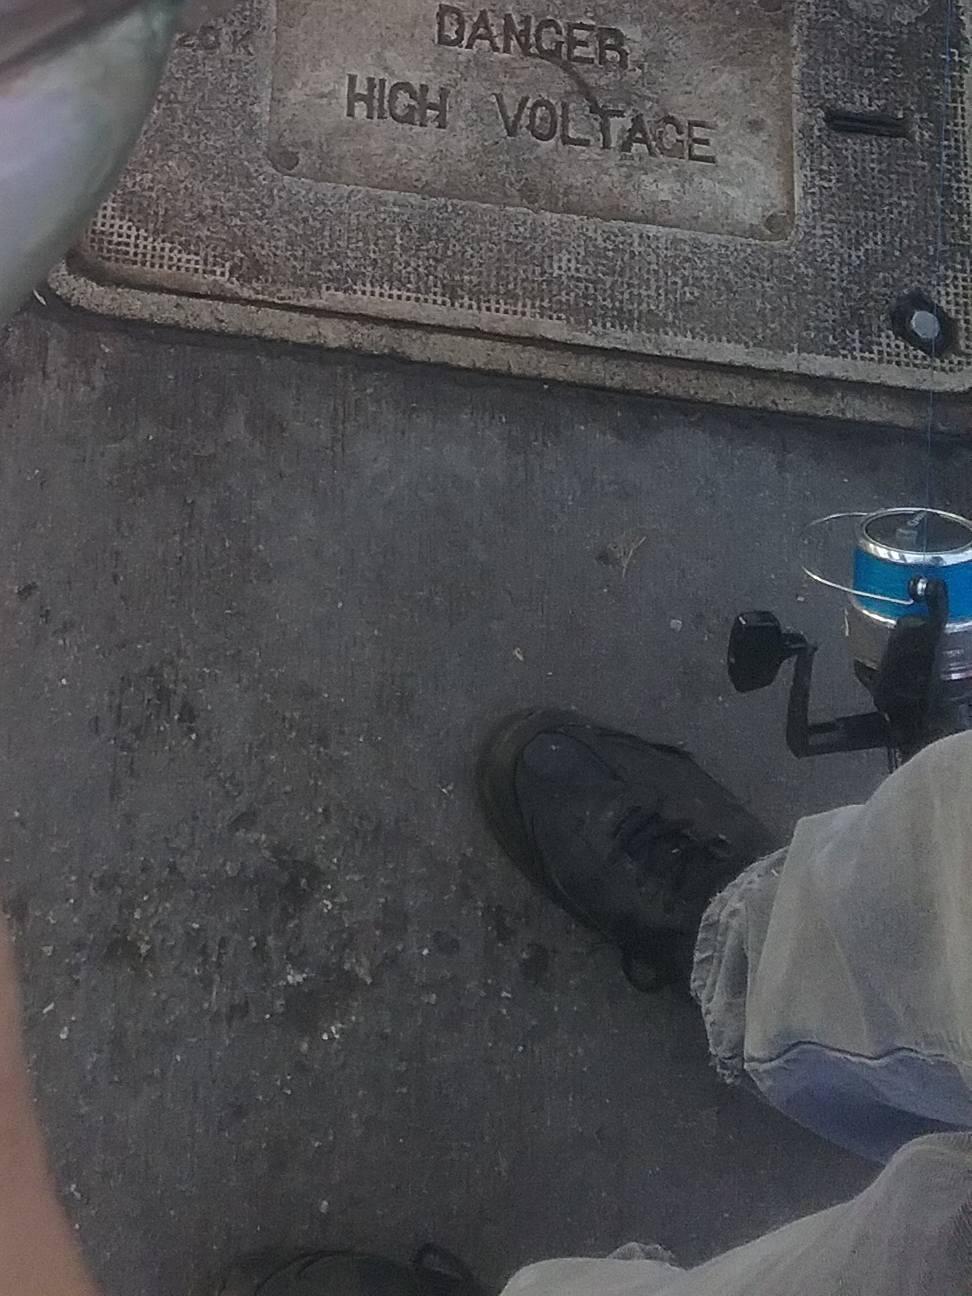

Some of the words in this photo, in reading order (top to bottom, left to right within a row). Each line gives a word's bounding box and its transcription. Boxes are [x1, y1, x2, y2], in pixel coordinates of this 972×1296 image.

[437, 2, 629, 70] DANGER
[346, 73, 448, 130] HIGH
[492, 91, 718, 164] VOLTAGE
